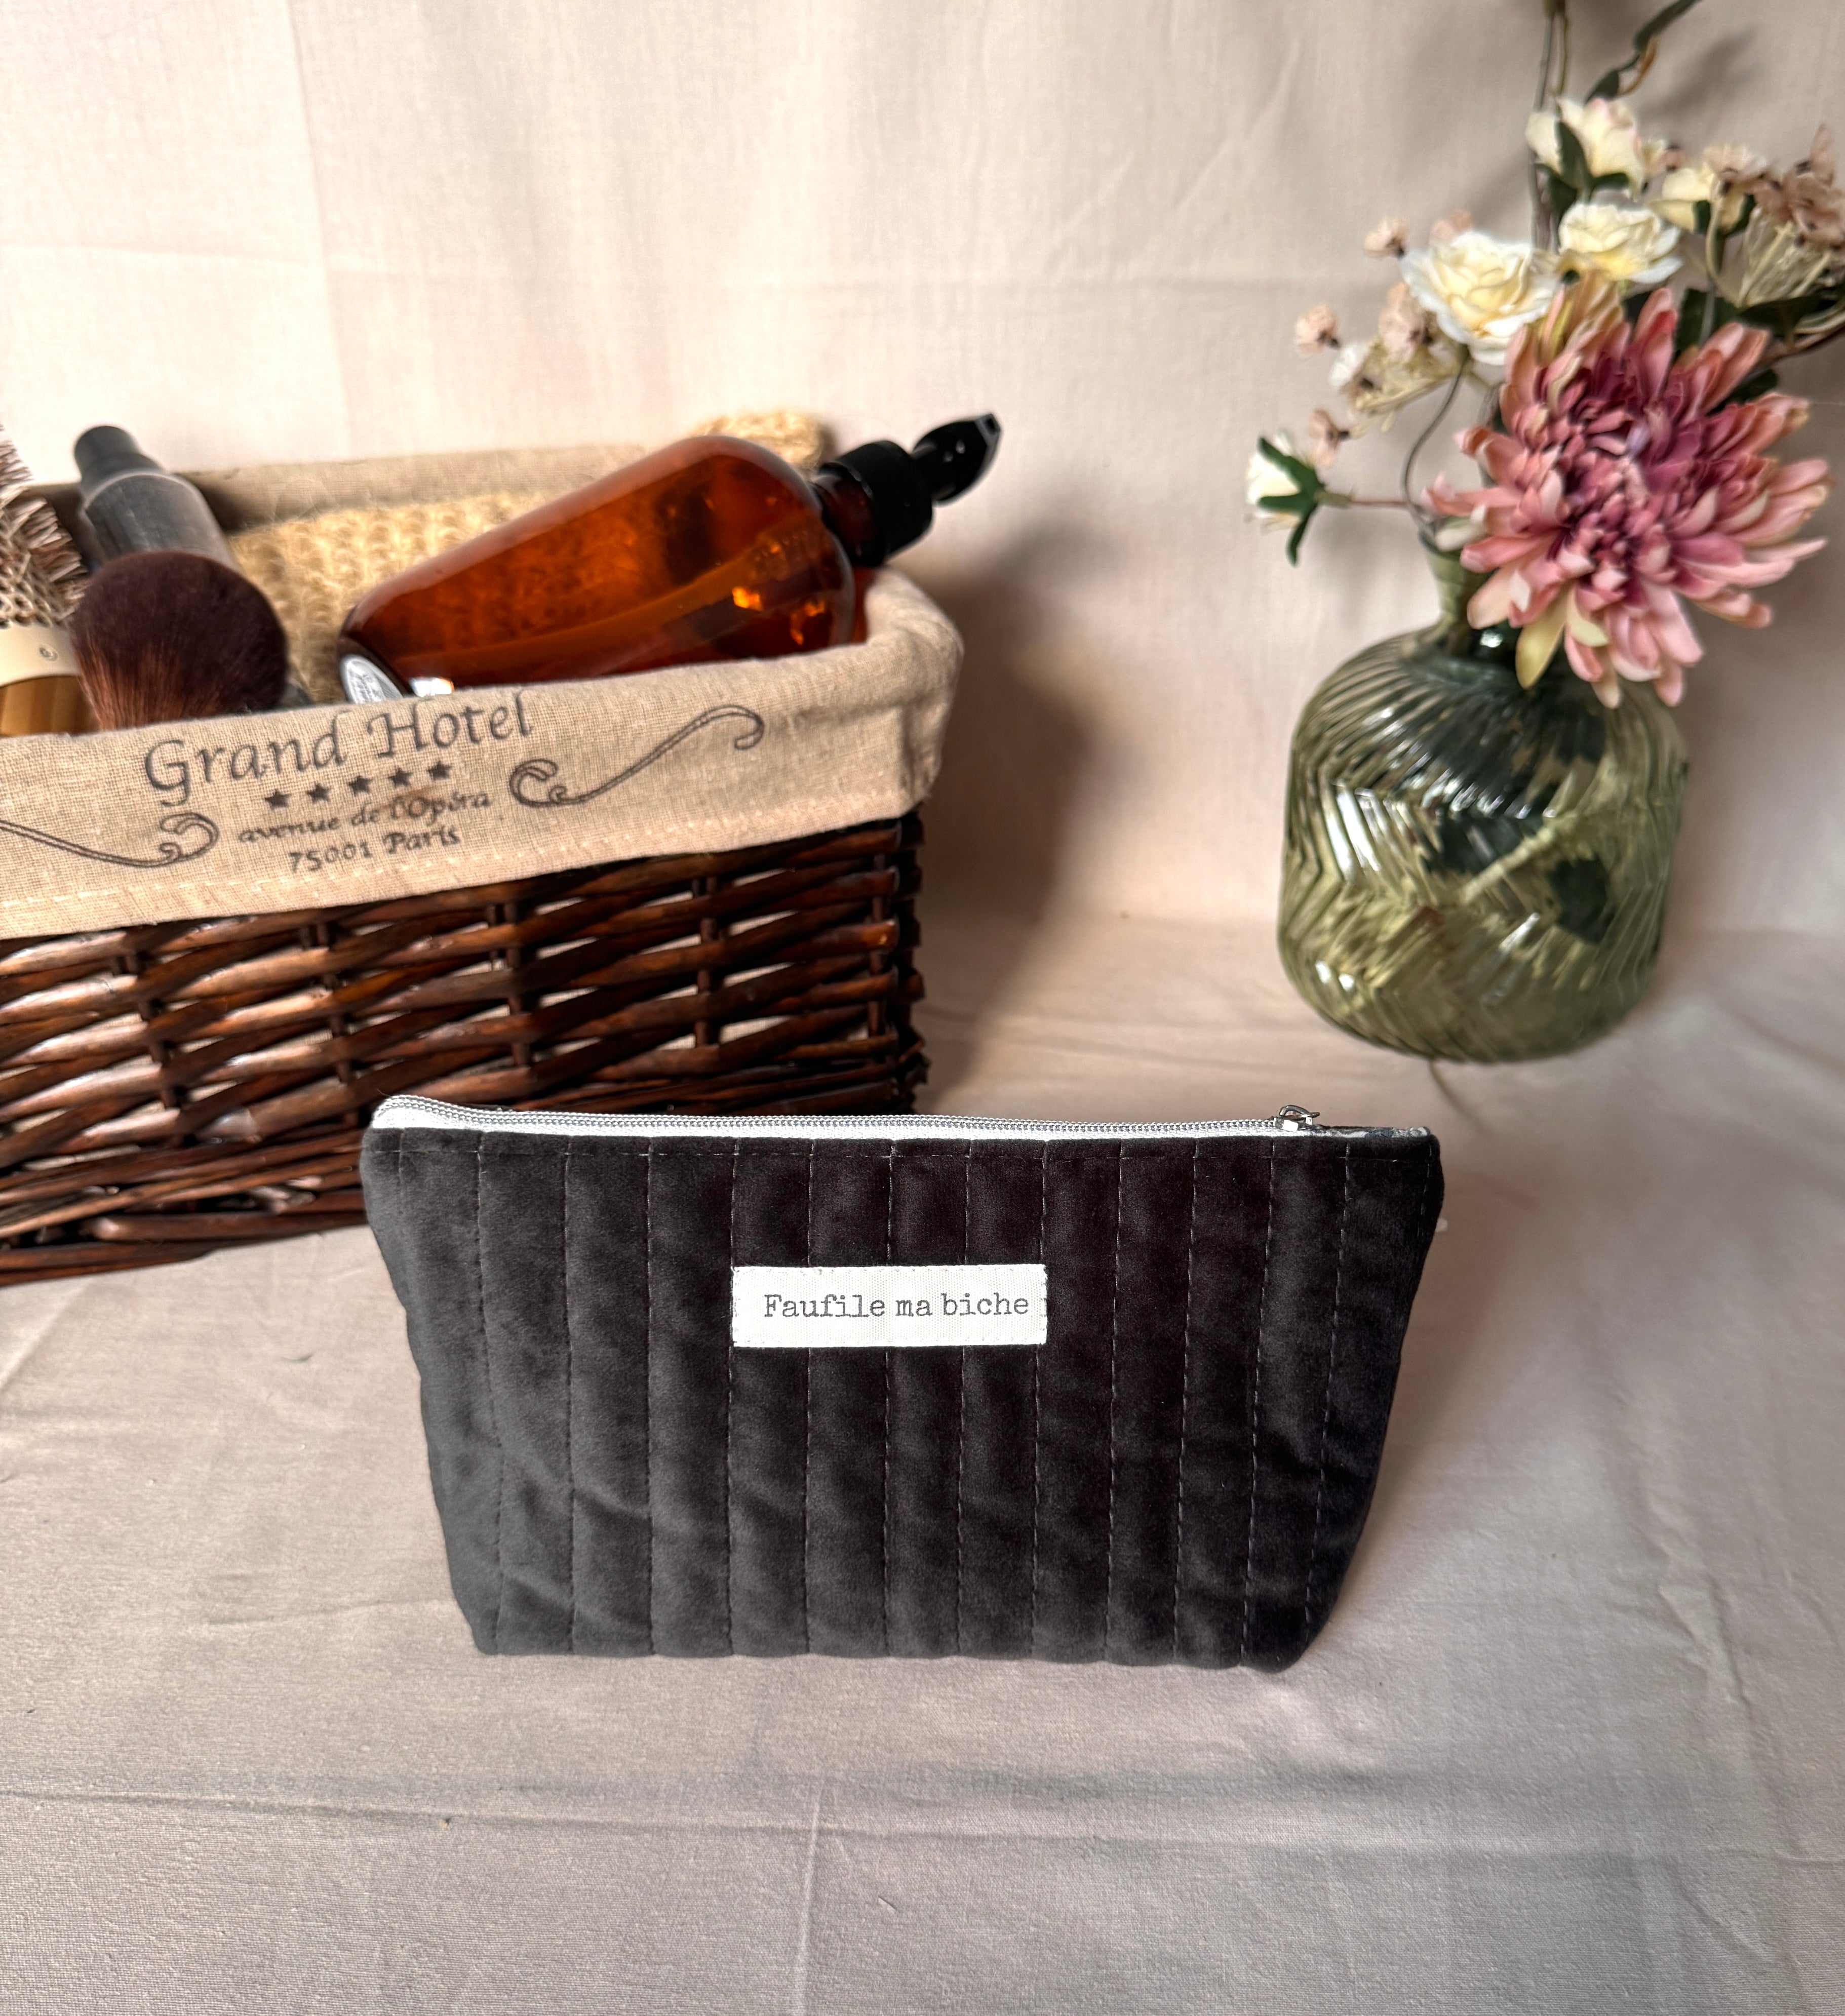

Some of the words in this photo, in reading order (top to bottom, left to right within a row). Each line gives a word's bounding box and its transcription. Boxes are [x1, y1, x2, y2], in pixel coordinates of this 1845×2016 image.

[145, 710, 350, 807] Grand
[367, 690, 534, 758] Hotel
[238, 817, 339, 843] avenue
[351, 802, 379, 827] de
[289, 839, 373, 873] 75001
[383, 824, 461, 854] Paris
[764, 1293, 885, 1317] Faufile
[895, 1297, 933, 1317] ma
[941, 1292, 1030, 1316] biche
